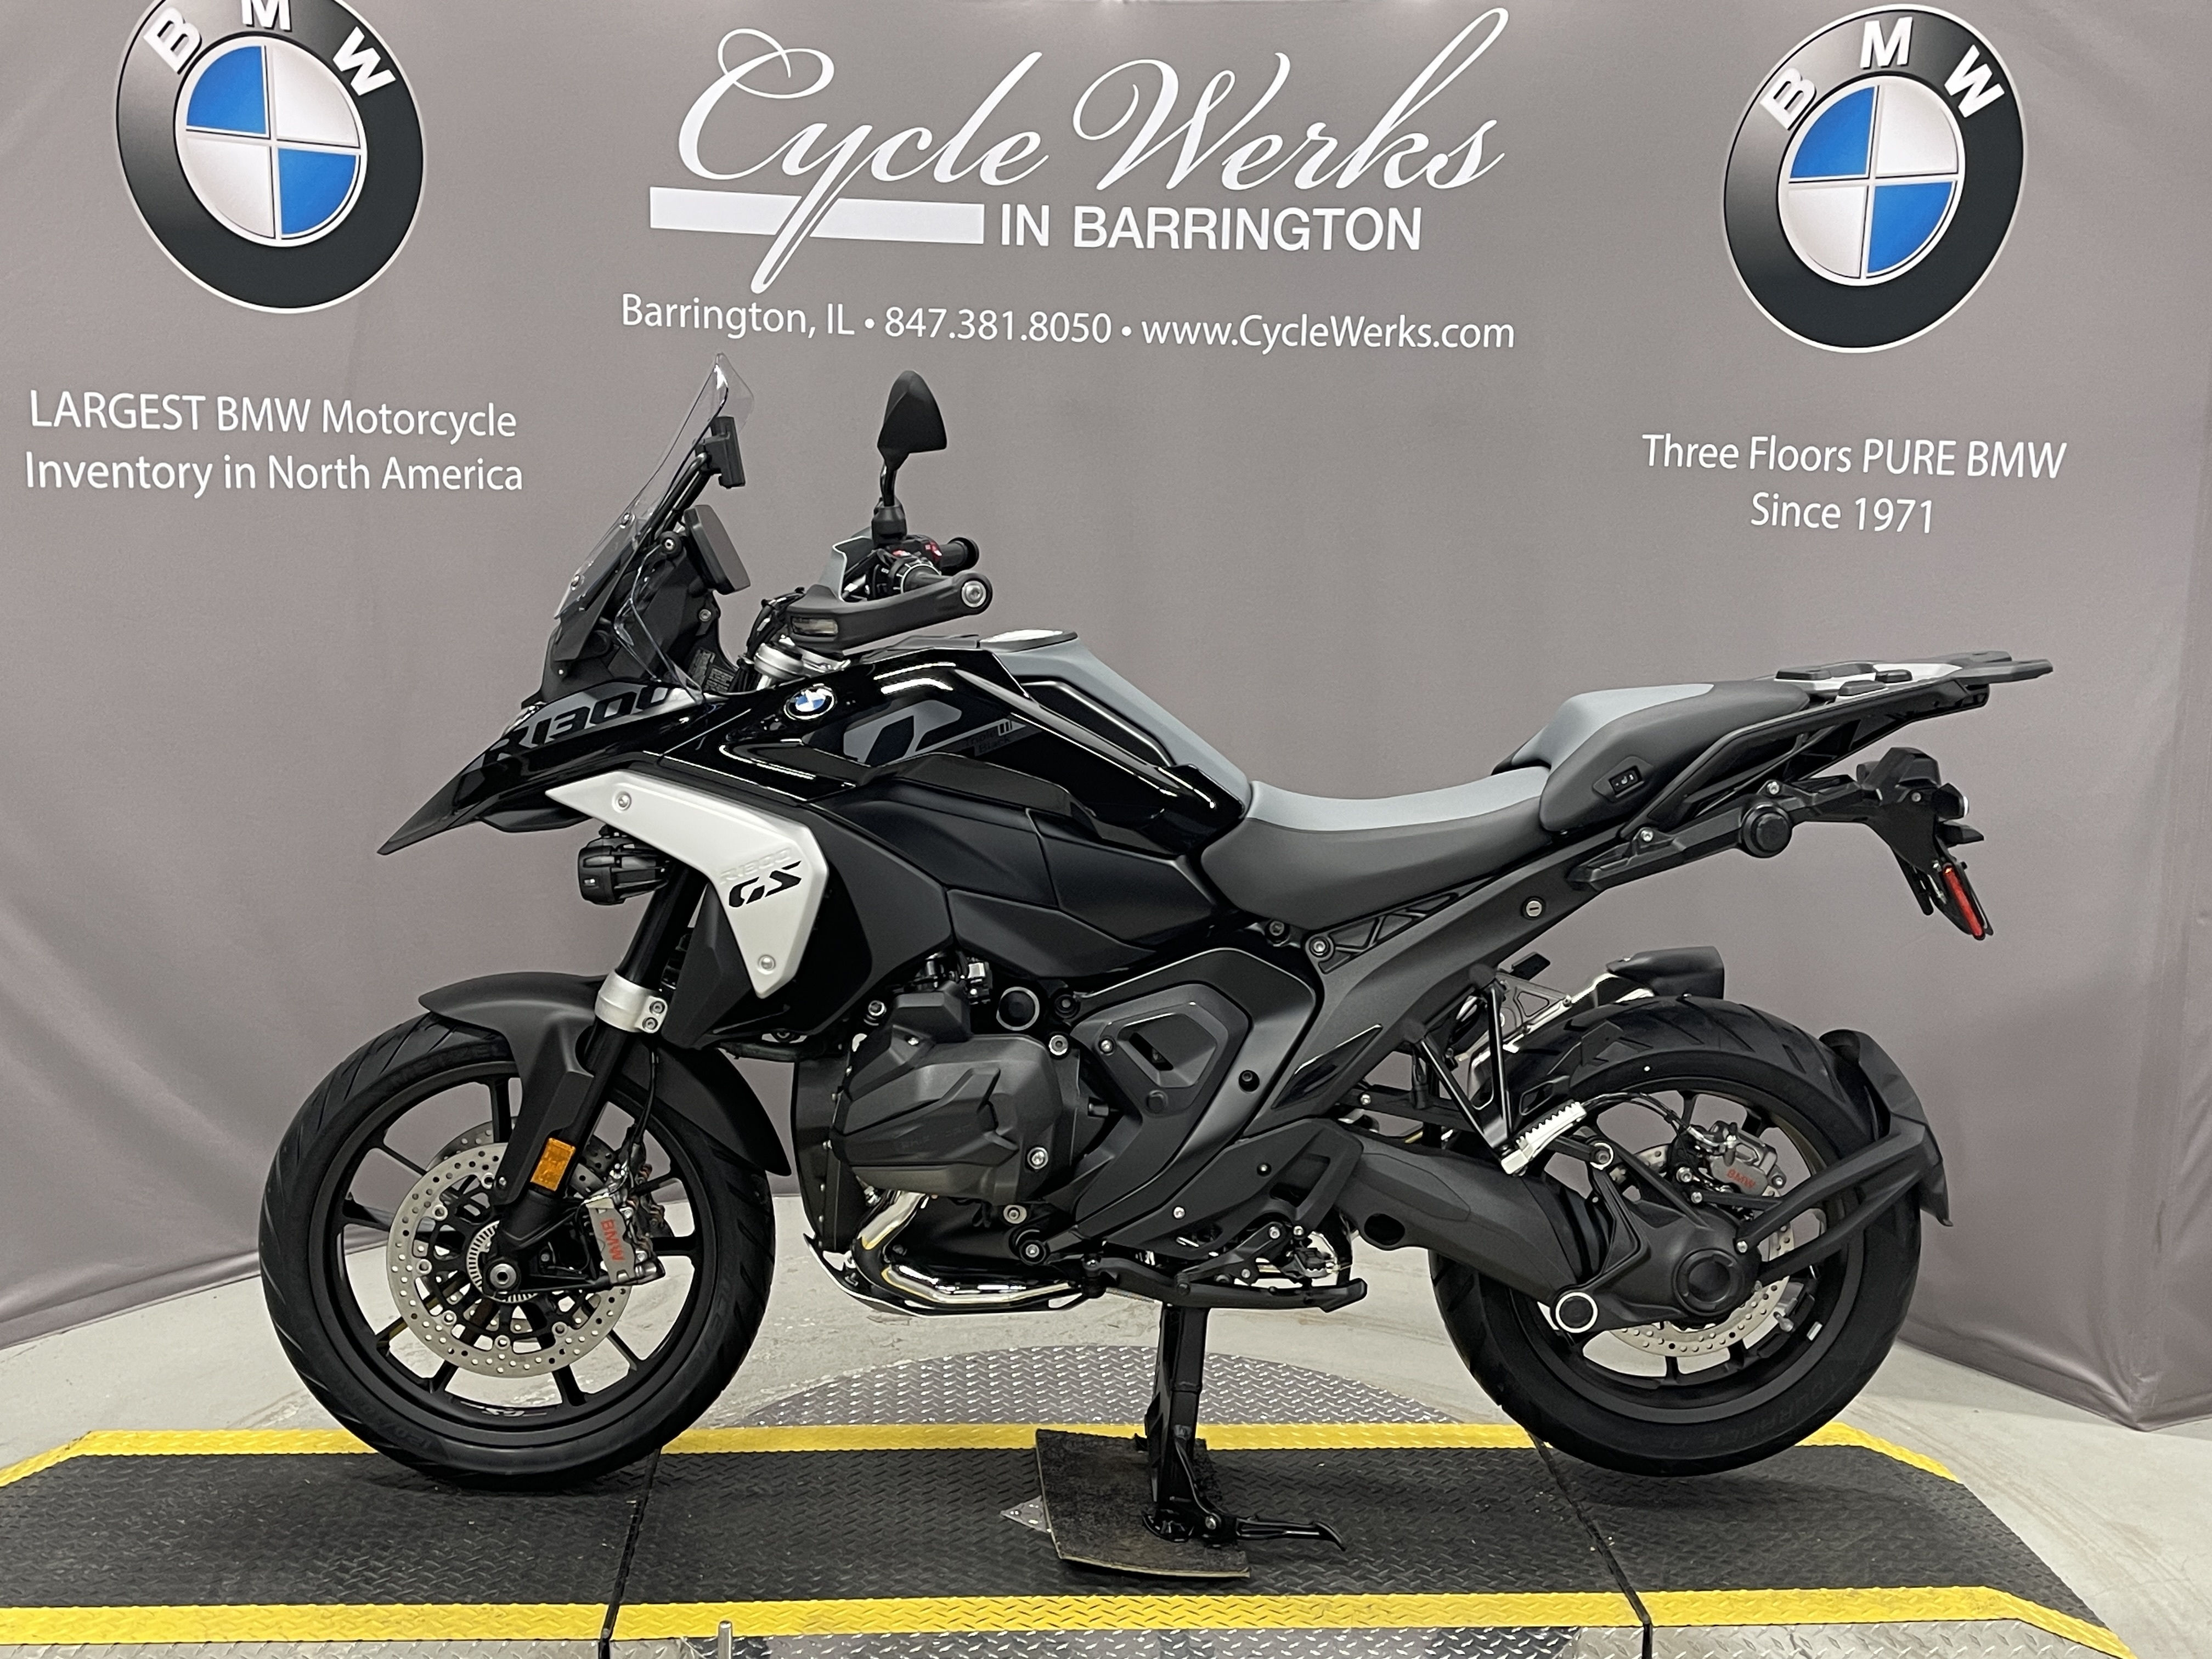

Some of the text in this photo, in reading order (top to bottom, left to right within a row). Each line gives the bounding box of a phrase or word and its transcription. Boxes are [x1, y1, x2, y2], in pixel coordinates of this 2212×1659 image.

[1759, 16, 2005, 131] BMW
[678, 7, 1509, 295] Cycle Werks
[1001, 203, 1422, 252] IN BARRINGTON
[622, 293, 1515, 356] Barrington, IL 847.381.8050 www.CycleWerks.com
[30, 389, 517, 445] LARGEST BMW Motorcycle
[26, 450, 523, 499] Inventory in North America
[1641, 432, 2068, 479] Three Floors PURE BMW
[1750, 491, 1933, 534] Since 1971
[727, 859, 803, 909] GS
[1725, 1168, 1756, 1189] BMW
[599, 1218, 625, 1262] BMW
